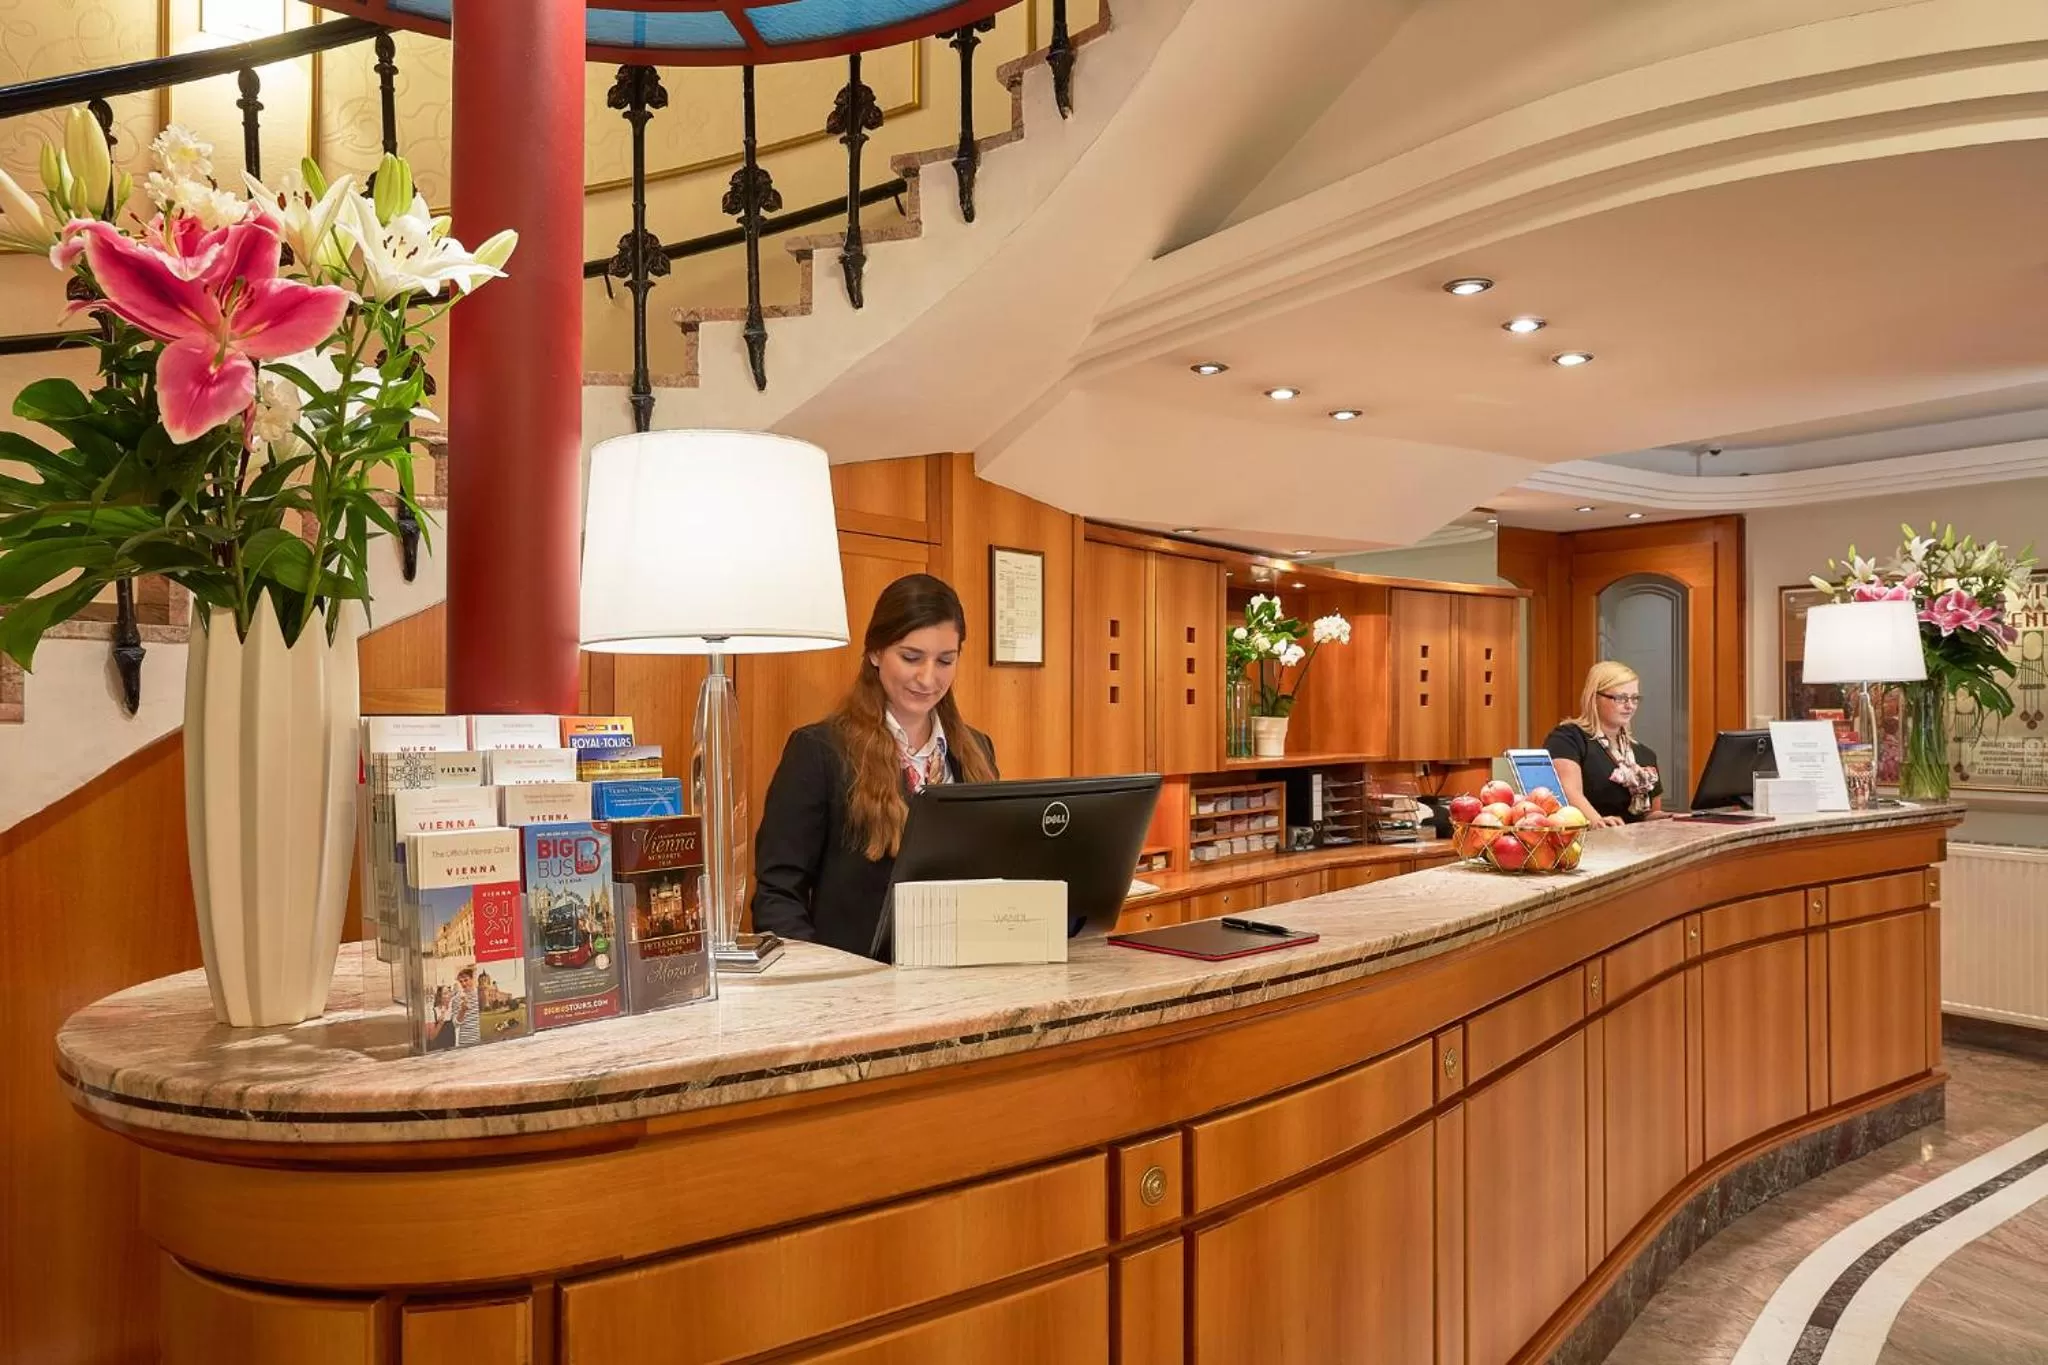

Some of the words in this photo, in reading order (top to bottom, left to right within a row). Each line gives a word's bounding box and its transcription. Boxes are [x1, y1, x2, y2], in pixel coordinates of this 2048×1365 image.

[440, 766, 477, 774] VIENNA
[529, 814, 569, 822] VIENNA
[1045, 814, 1066, 825] DELL
[418, 819, 476, 831] VIENNA
[632, 824, 696, 854] Vienna
[537, 838, 574, 859] BIG
[446, 864, 497, 876] VIENNA
[538, 859, 574, 879] BUS
[482, 890, 512, 898] VIENNA
[646, 959, 698, 985] Mozart
